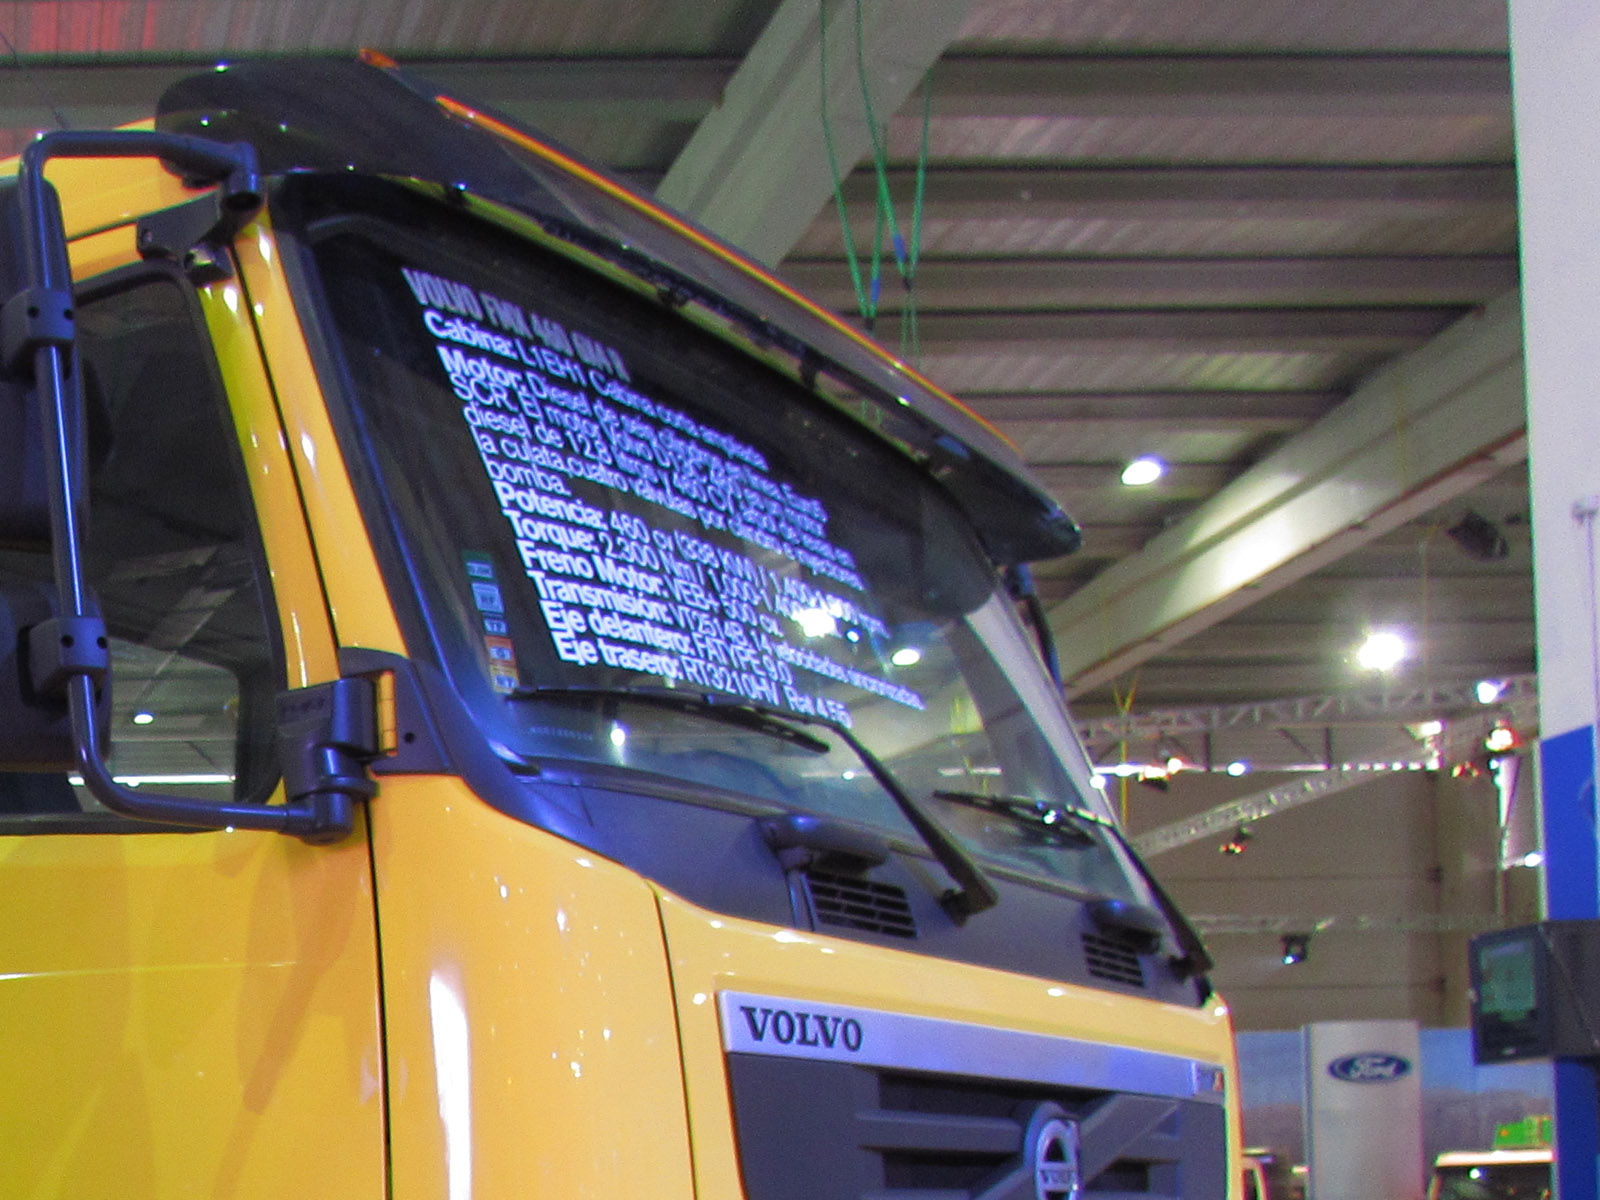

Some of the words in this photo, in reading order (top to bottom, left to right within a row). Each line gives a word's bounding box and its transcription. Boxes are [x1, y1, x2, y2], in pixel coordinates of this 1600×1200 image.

[423, 310, 518, 360] Cabina:
[514, 338, 587, 387] L1EH1
[525, 371, 592, 416] Diesel
[463, 400, 532, 439] diesel
[534, 421, 564, 449] de
[470, 423, 499, 455] la
[541, 400, 602, 440] motor
[482, 452, 572, 496] bomba.
[492, 479, 609, 531] Potencia:
[502, 508, 599, 553] Torque:
[598, 531, 660, 570] 2.300
[658, 549, 697, 581] Nm
[515, 538, 595, 579] Freno
[591, 553, 669, 598] Motor:
[664, 574, 720, 613] VEB+
[719, 593, 759, 627] 500
[526, 569, 674, 625] Transmisión:
[539, 599, 588, 639] Eje
[586, 607, 695, 657] delantero:
[551, 630, 599, 667] Eje
[596, 637, 683, 680] trasero:
[740, 1006, 863, 1053] VOLVO
